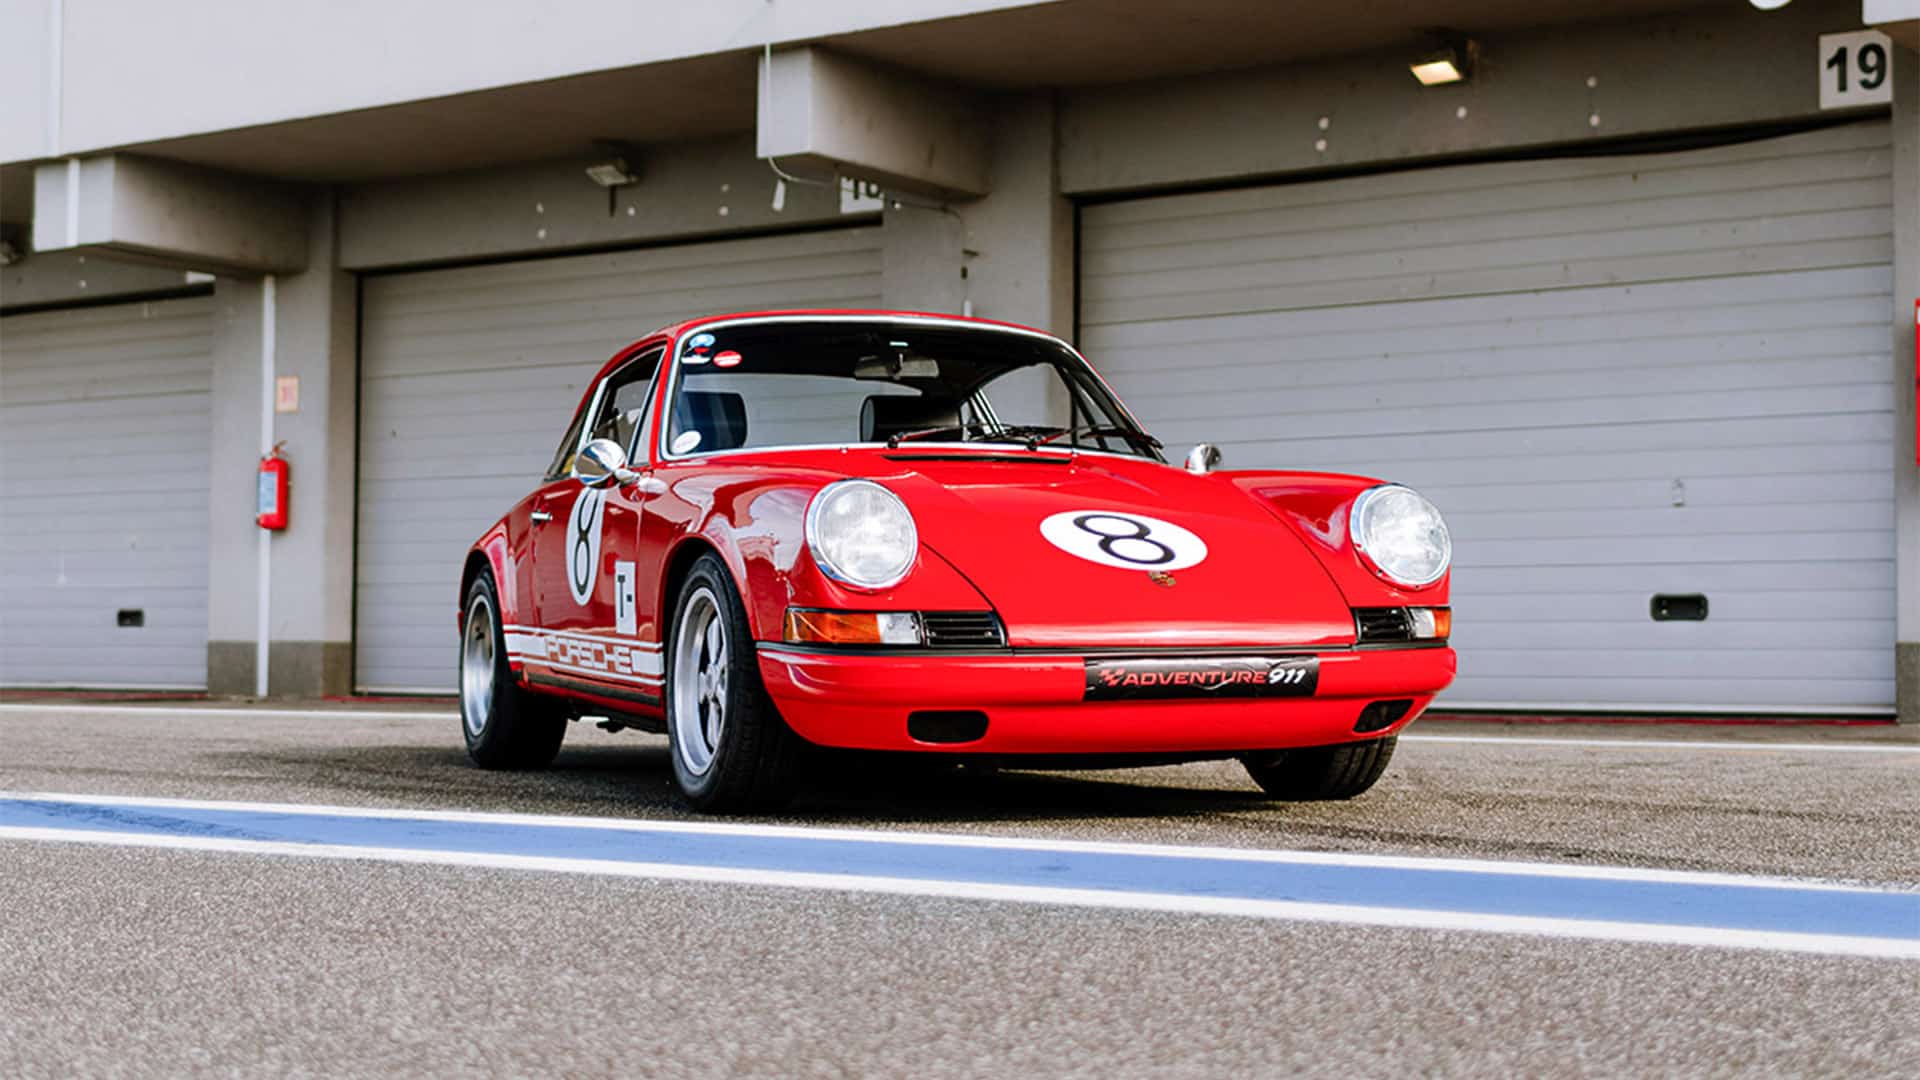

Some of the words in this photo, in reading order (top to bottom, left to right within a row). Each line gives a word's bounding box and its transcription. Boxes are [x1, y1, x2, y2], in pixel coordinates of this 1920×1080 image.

[1826, 43, 1887, 92] 19
[574, 488, 600, 596] 8
[1073, 514, 1176, 565] 8
[546, 636, 633, 674] PORSCHE
